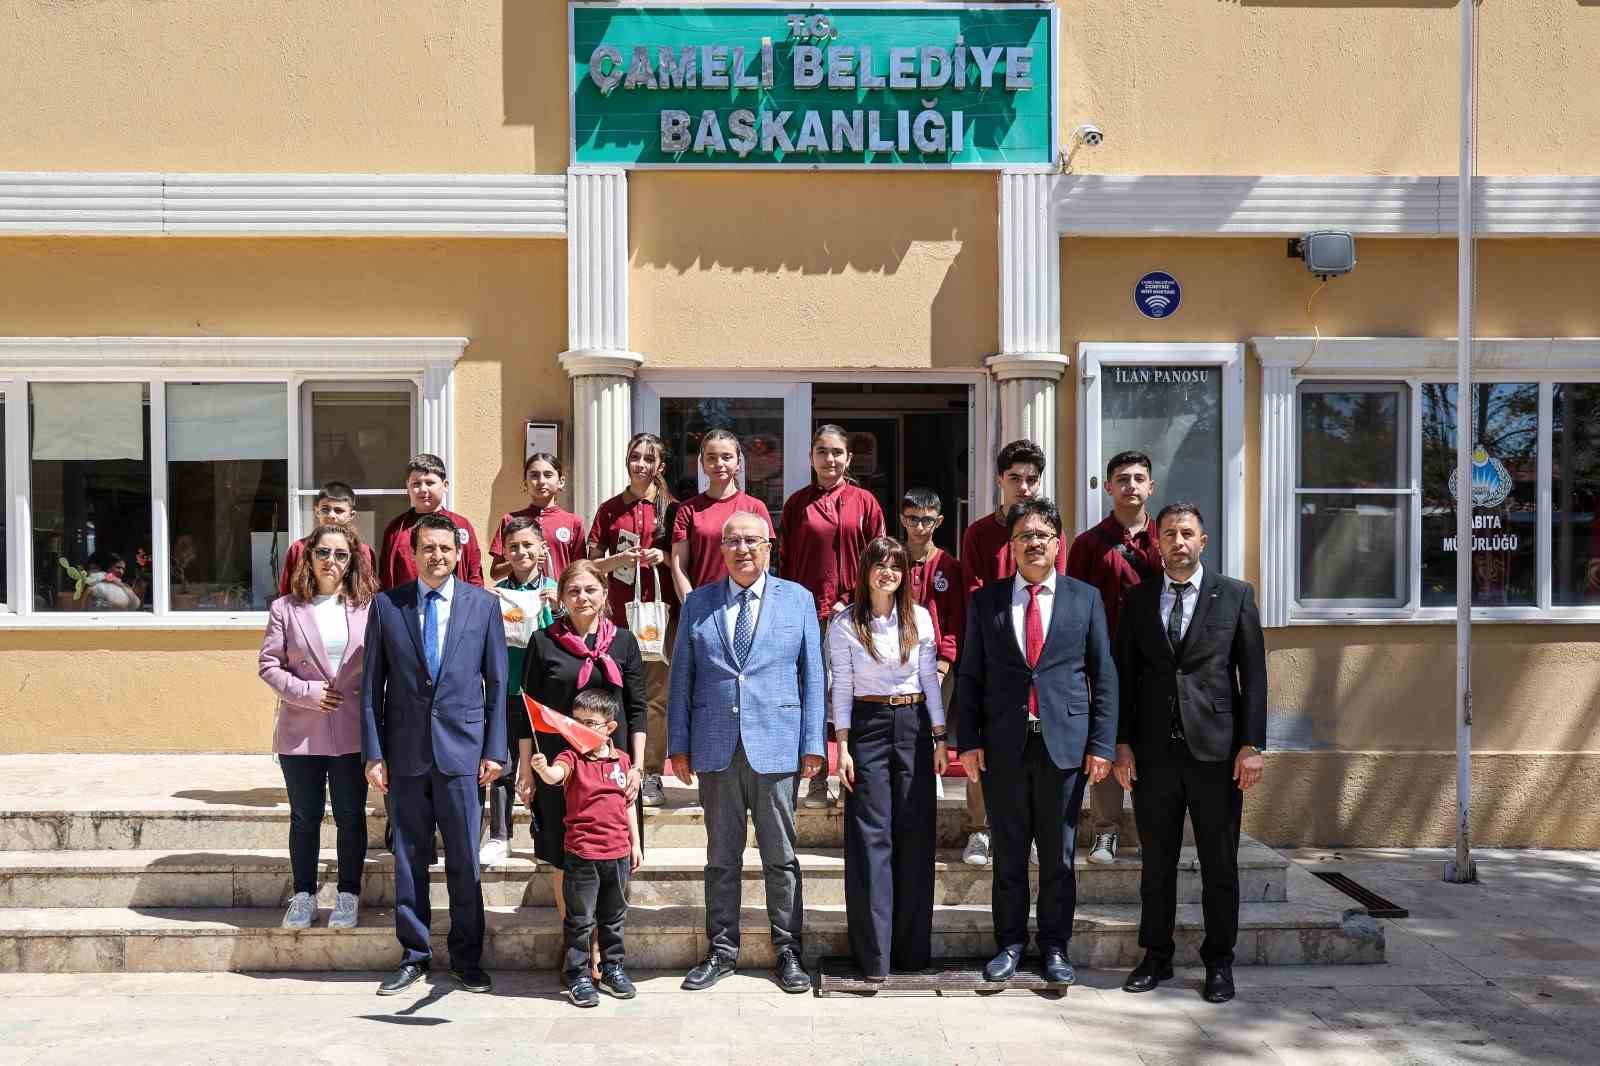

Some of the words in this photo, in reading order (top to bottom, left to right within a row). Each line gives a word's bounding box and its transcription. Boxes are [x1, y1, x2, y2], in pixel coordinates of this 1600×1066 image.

[787, 14, 837, 40] T.C.
[590, 37, 774, 96] ÇAMELİ
[793, 35, 1034, 90] BELEDİYE
[660, 97, 964, 158] BAŞKANLIĞI
[1116, 367, 1150, 383] İLAN
[1154, 370, 1209, 383] PANOSU
[1471, 515, 1502, 529] BITA
[1443, 534, 1518, 552] MÜÜRLÜĞÜ
